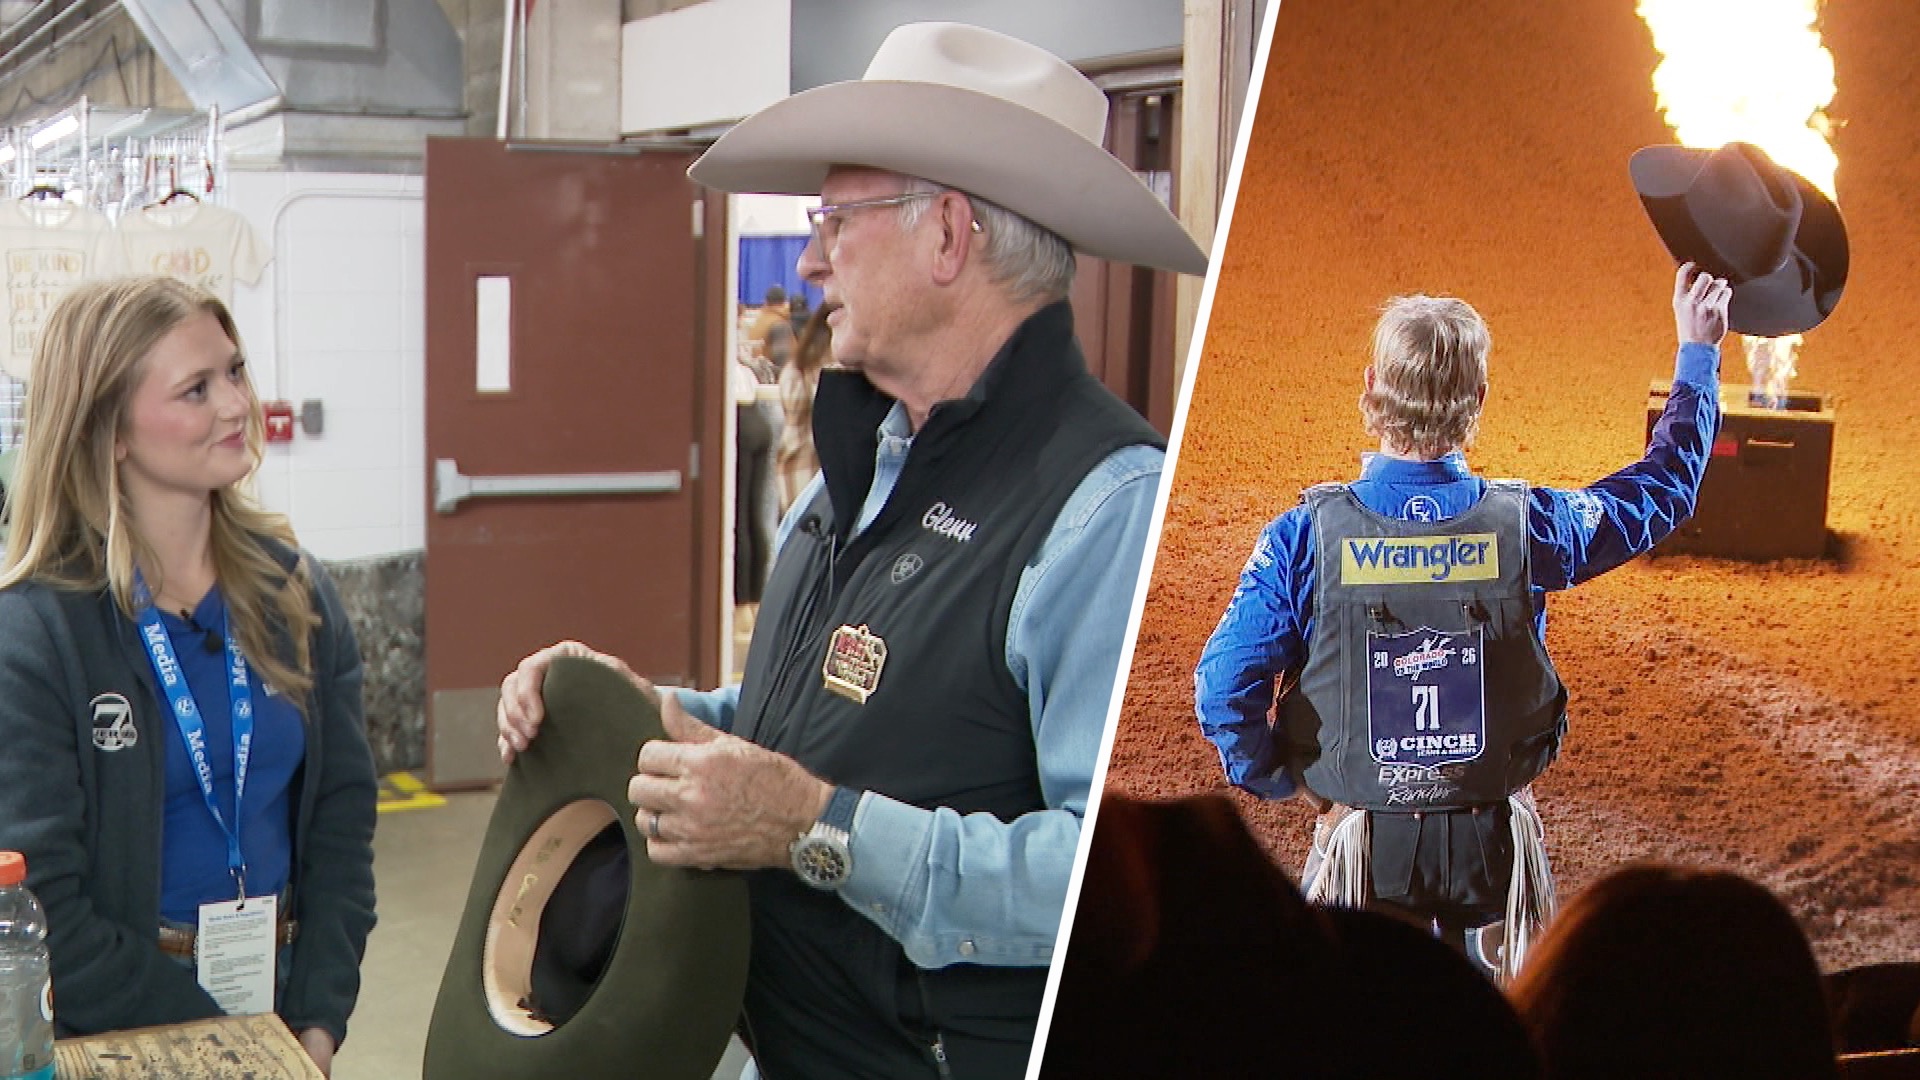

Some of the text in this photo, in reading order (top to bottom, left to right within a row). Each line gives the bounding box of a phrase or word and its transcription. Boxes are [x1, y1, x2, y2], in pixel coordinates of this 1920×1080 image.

[922, 502, 978, 542] Glenn
[1349, 538, 1490, 580] Wrangler
[143, 621, 177, 687] Media
[1373, 651, 1388, 668] 20
[1394, 648, 1445, 667] COLORADO
[1461, 647, 1476, 664] 26
[1411, 685, 1440, 731] 71
[187, 727, 213, 797] Media
[1400, 733, 1477, 751] CINCH
